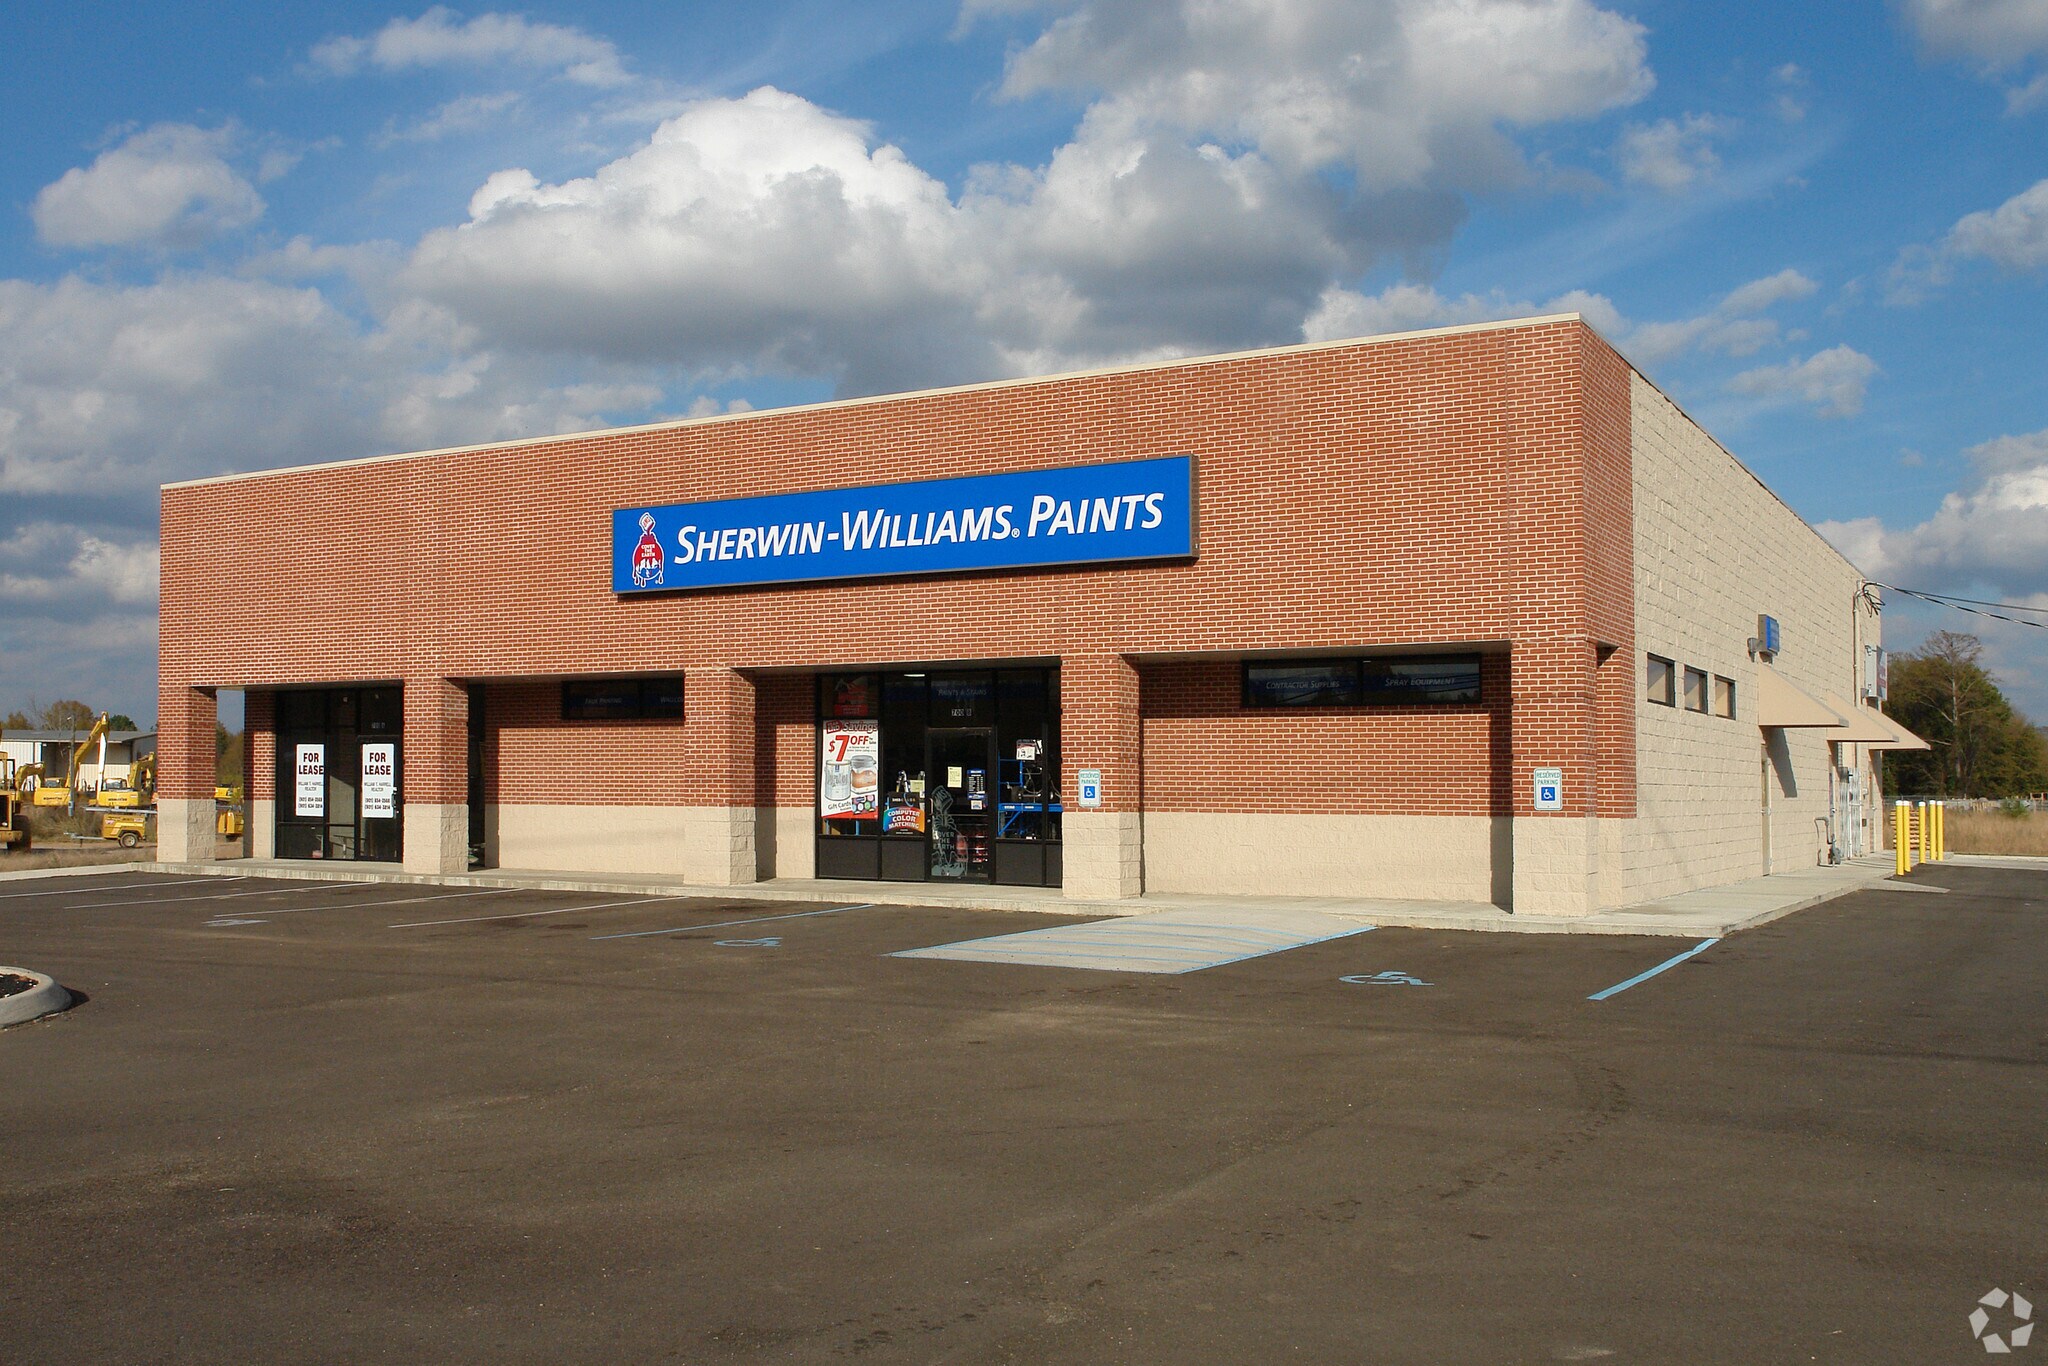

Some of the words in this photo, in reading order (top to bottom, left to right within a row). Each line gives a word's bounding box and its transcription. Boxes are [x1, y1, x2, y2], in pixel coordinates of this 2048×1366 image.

[1026, 491, 1165, 538] PAINTS
[1265, 681, 1309, 690] CONTRACTOR
[1310, 680, 1340, 689] SUPPLIES
[1384, 677, 1409, 687] SPRAY
[1410, 676, 1456, 686] EQUIPMENT
[937, 688, 959, 697] PAINTS
[842, 720, 879, 735] Savings
[850, 735, 869, 745] OFF
[303, 752, 319, 763] FOR
[369, 752, 386, 763] FOR
[298, 765, 325, 775] LEASE
[364, 765, 391, 776] LEASE
[887, 810, 921, 818] COMPUTER
[892, 815, 917, 823] COLOR
[888, 821, 920, 830] MATCHING
